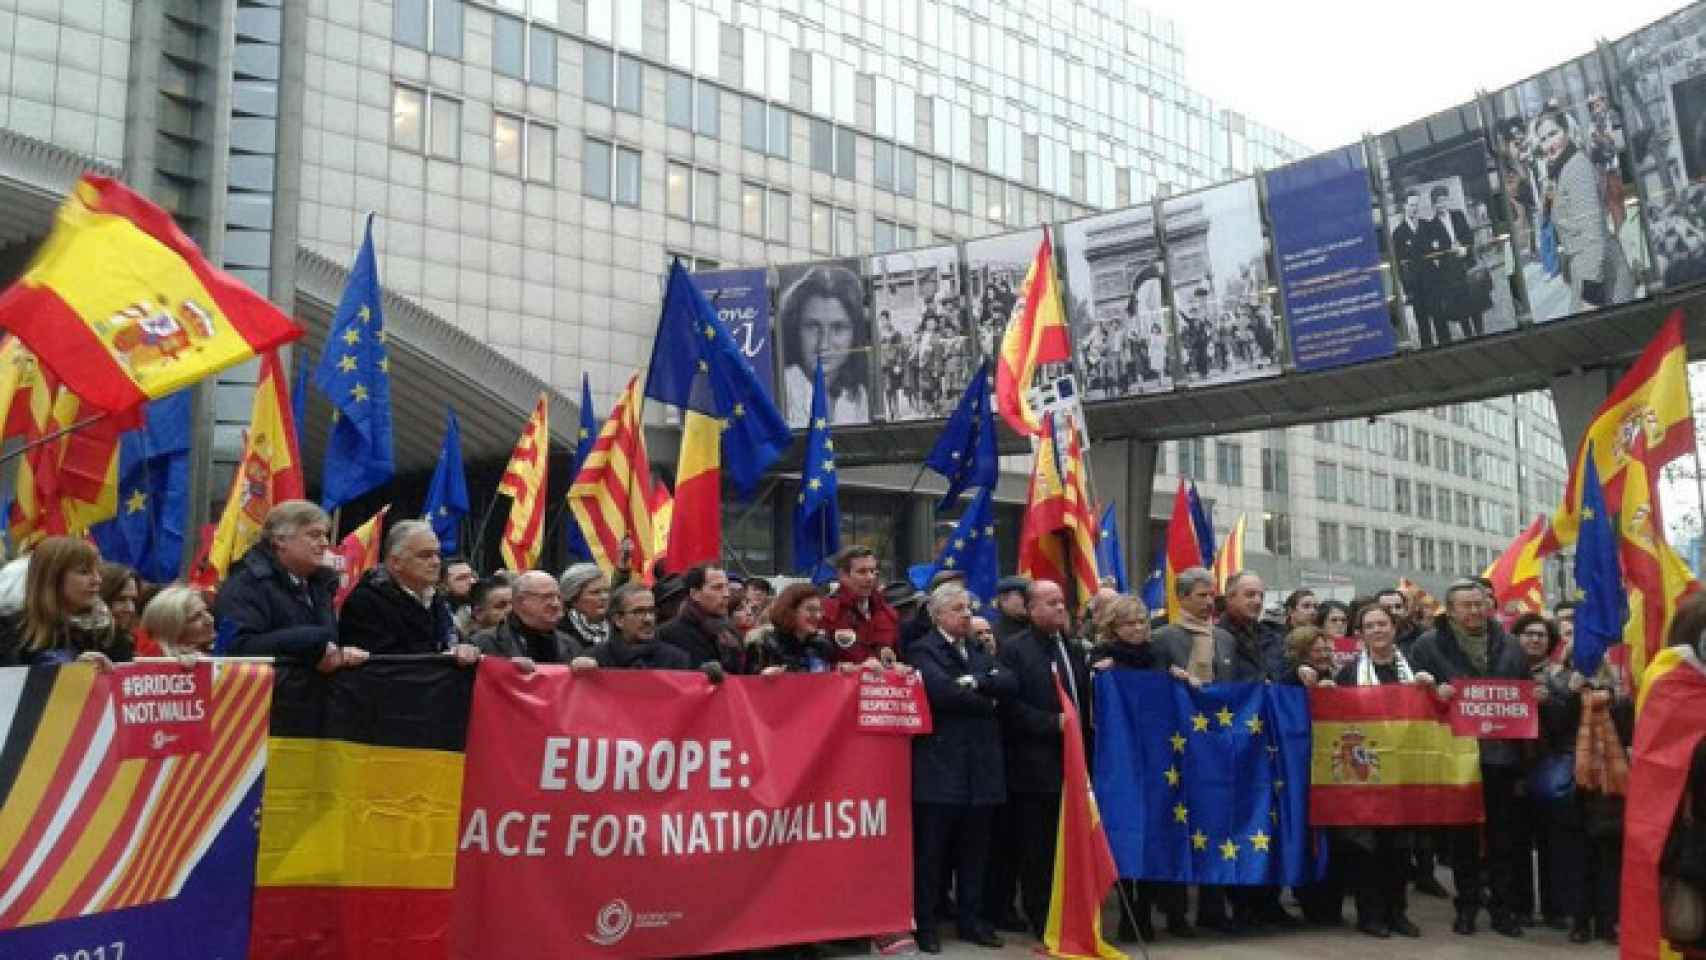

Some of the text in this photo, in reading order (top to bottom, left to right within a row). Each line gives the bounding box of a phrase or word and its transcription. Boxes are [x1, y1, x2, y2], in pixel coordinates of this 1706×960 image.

[123, 674, 196, 696] #BRIDGES
[1464, 686, 1519, 700] #BETTER
[1459, 701, 1529, 718] TOGETHER
[539, 736, 752, 792] EUROPE:
[460, 797, 888, 857] ACE FOR NATIONALISM
